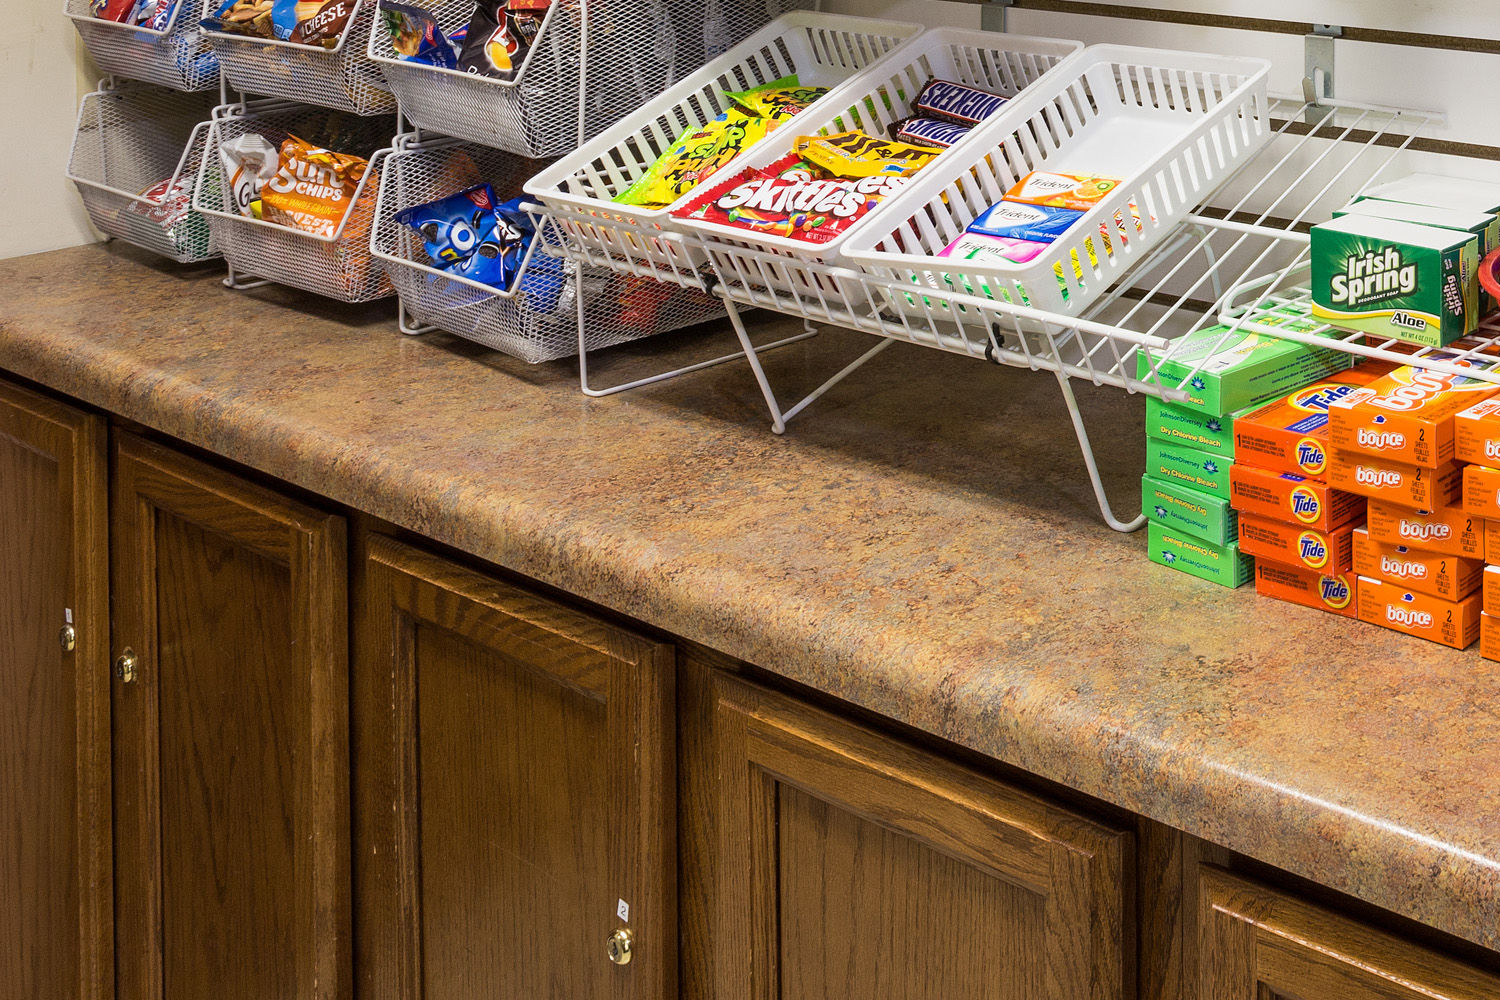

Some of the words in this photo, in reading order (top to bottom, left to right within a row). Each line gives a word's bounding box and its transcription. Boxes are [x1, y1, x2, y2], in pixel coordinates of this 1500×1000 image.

[305, 1, 347, 34] CHEESE
[268, 156, 344, 194] Sun
[295, 182, 344, 201] CHIPS
[716, 178, 865, 218] Skittles
[998, 208, 1042, 221] Trident
[1348, 246, 1400, 280] Irish
[1331, 264, 1418, 306] Spring
[1391, 311, 1425, 330] Aloe
[1159, 410, 1203, 428] JohnsonDiversey
[1160, 426, 1172, 436] Dry
[1172, 428, 1198, 442] Chlorine
[1198, 434, 1221, 448] Bleach
[1358, 428, 1405, 449] bounce
[1159, 450, 1200, 469] JohnsonDiversey
[1298, 445, 1324, 467] Tide
[1355, 466, 1403, 488] bounce
[1292, 493, 1318, 515] Tide
[1400, 519, 1452, 541] bounce
[1380, 557, 1429, 579] bounce
